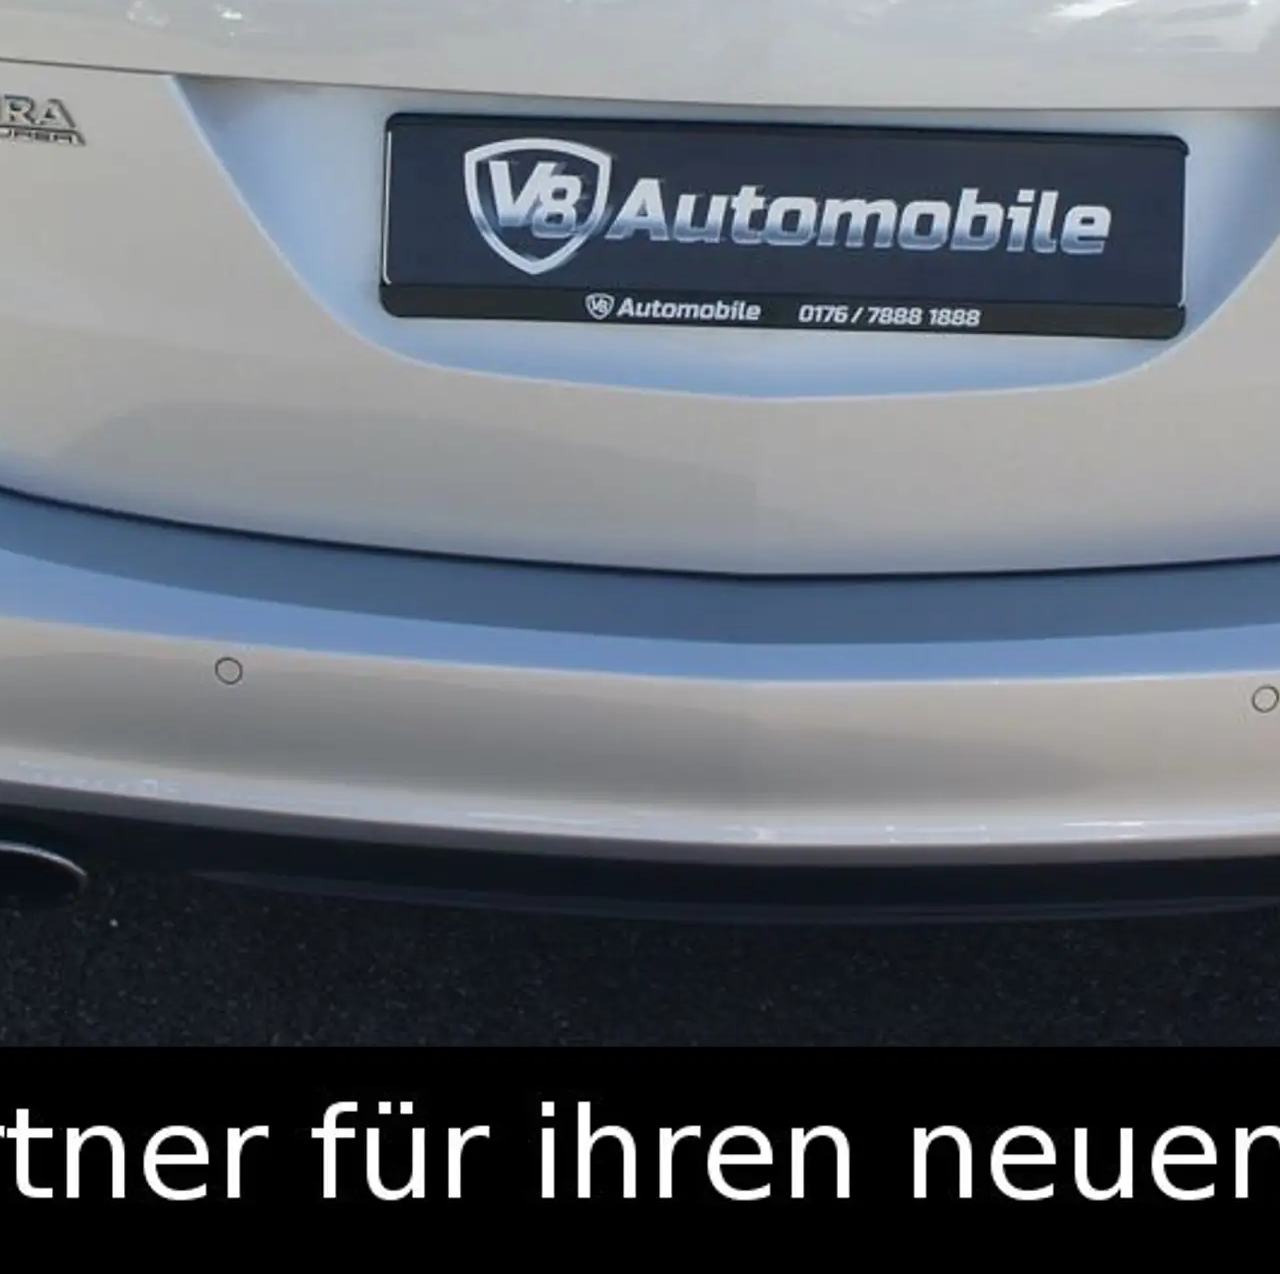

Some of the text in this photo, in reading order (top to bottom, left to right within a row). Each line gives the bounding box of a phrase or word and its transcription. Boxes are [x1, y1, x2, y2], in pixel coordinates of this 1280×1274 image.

[488, 159, 1113, 255] V8 Automobile
[616, 297, 762, 321] Automobile
[798, 304, 850, 324] 0176
[867, 306, 923, 326] 7888
[928, 308, 982, 327] 1888
